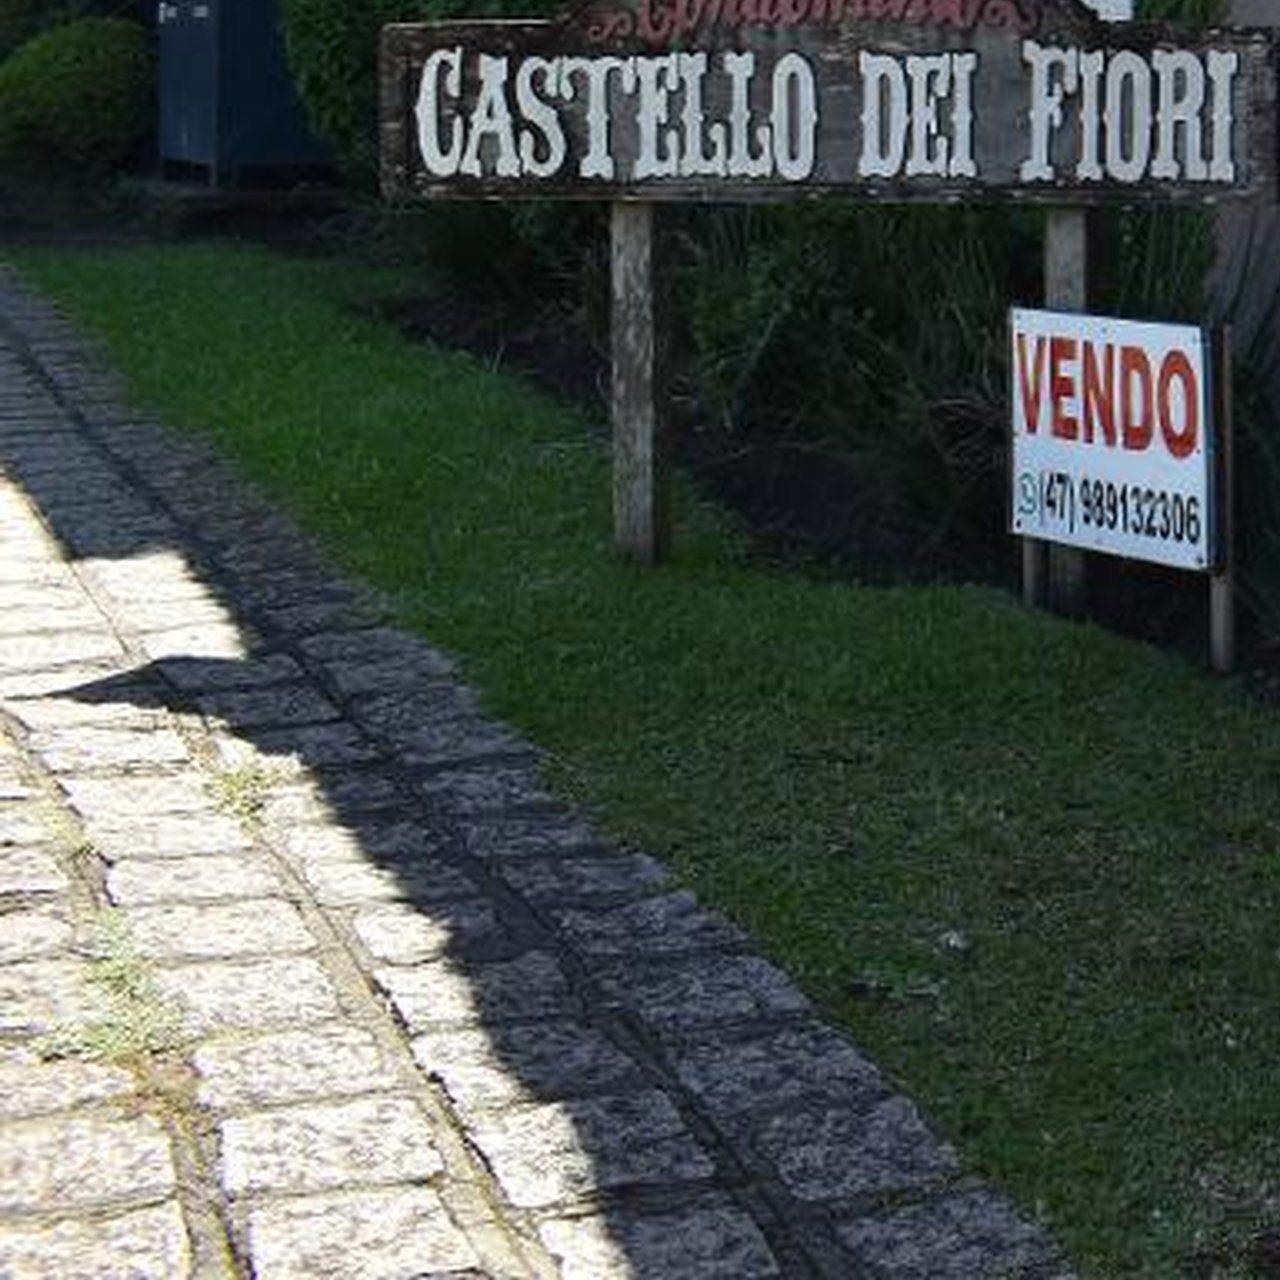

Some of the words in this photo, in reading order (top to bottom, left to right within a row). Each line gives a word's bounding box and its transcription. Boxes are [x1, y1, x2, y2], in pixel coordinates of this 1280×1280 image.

[413, 46, 819, 181] CASTELLO
[858, 51, 980, 179] DEI
[1020, 38, 1240, 185] FIORI
[1016, 332, 1198, 460] VENDO
